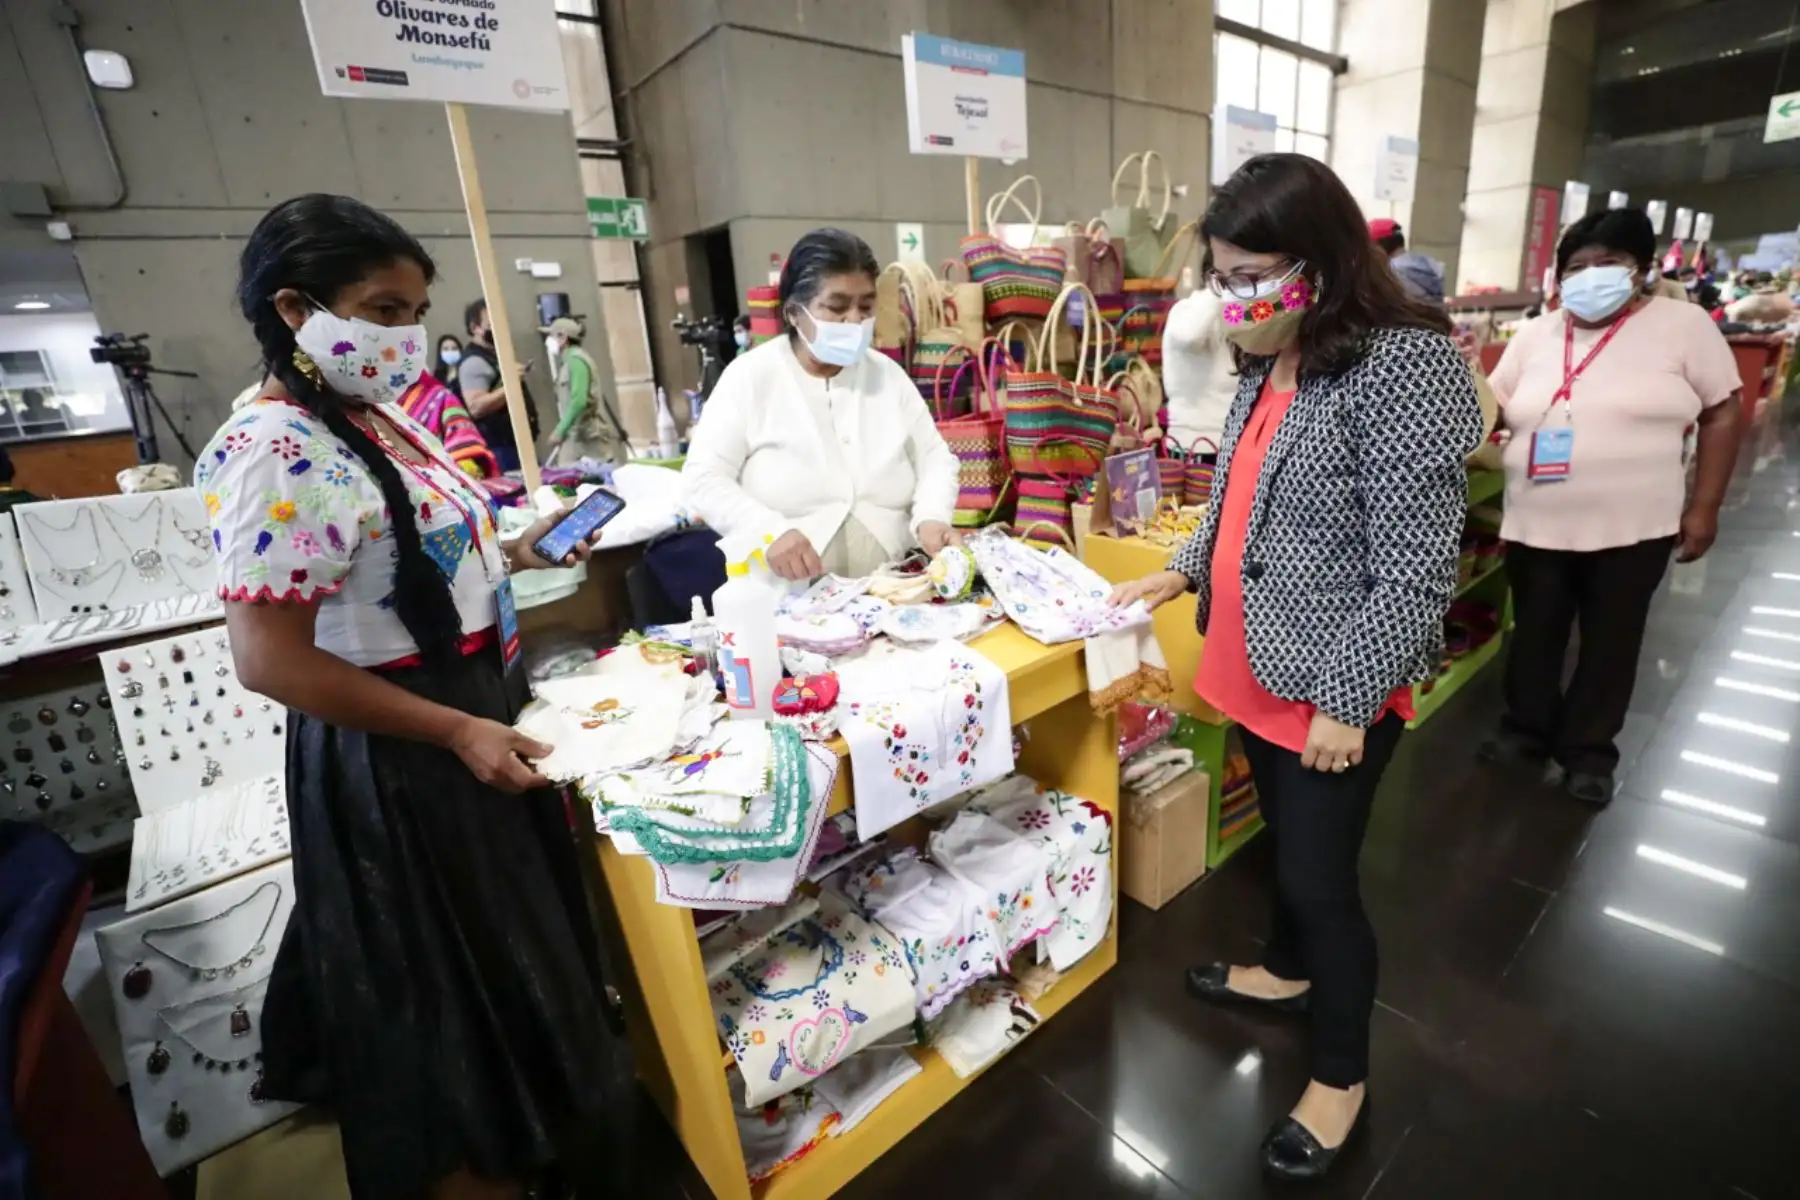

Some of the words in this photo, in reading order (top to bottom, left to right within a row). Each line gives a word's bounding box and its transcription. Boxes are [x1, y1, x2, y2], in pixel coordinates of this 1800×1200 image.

[376, 0, 469, 28] Olivares
[474, 12, 499, 31] de
[395, 23, 491, 51] Monsefú
